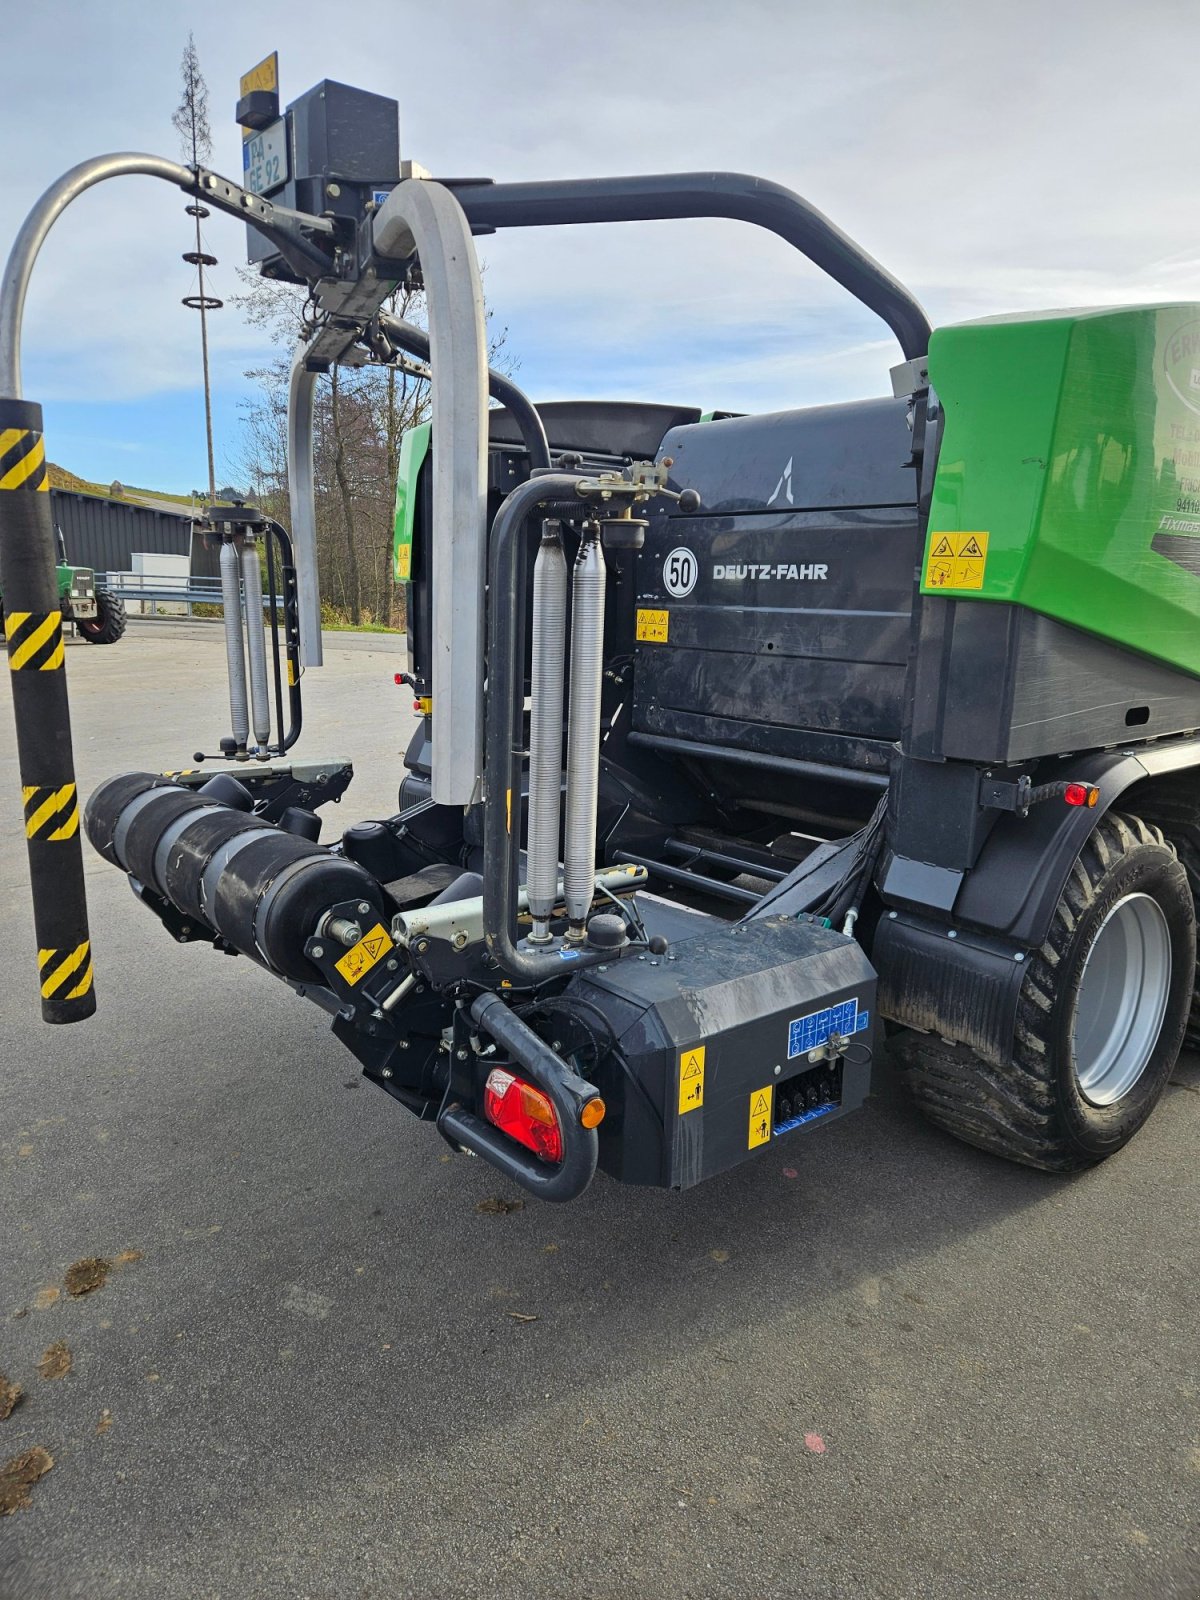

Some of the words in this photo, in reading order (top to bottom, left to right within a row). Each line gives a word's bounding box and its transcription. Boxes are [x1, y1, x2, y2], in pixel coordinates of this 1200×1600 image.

[265, 155, 280, 186] 92
[669, 557, 691, 588] 50
[713, 564, 828, 580] DEUTZ-FAHR
